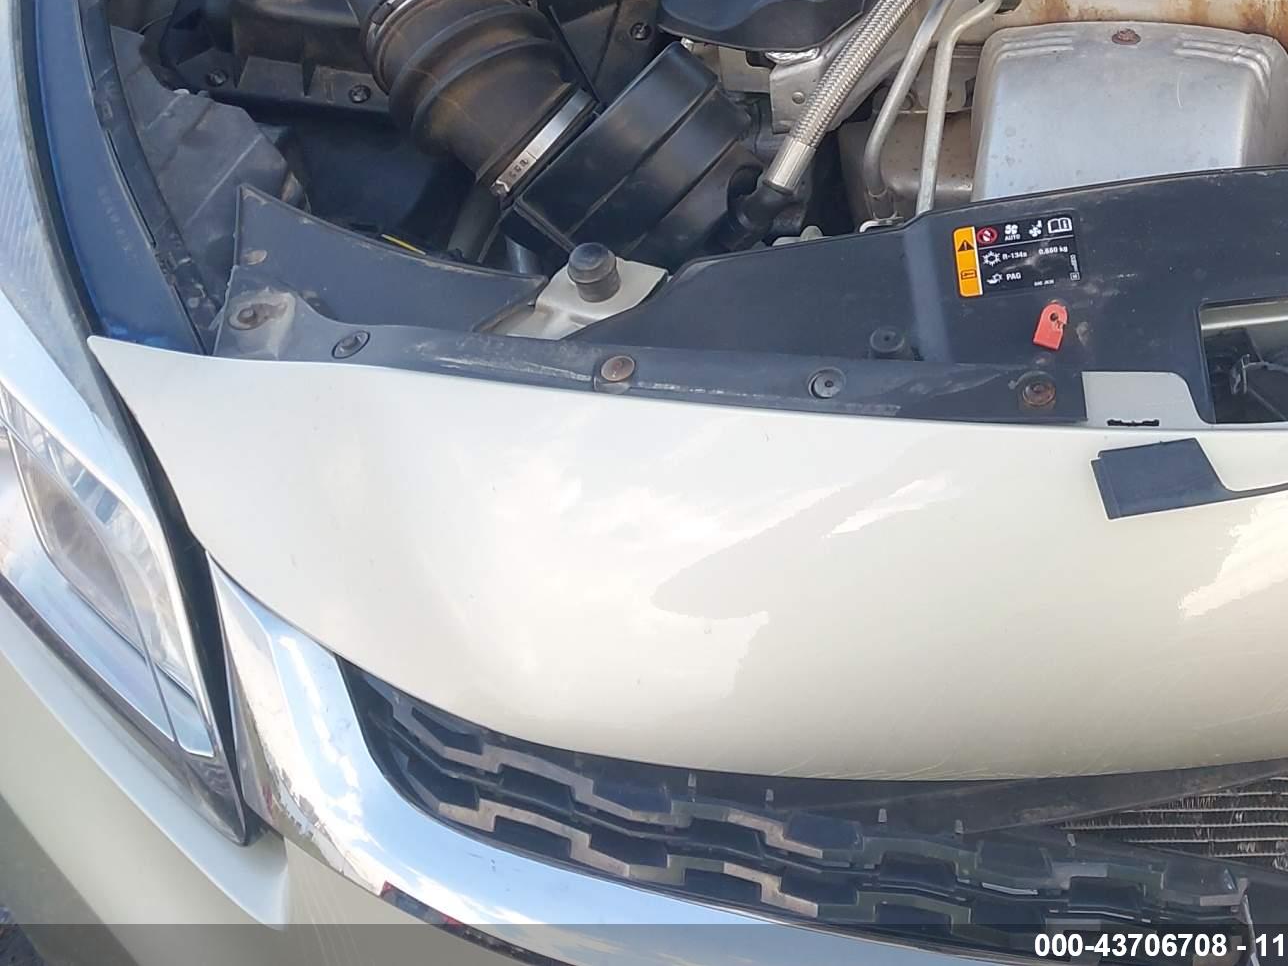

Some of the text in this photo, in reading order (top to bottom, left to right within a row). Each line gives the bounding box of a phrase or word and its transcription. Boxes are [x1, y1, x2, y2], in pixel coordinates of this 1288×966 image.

[1004, 233, 1021, 242] AUTO
[1002, 251, 1028, 261] R-134a
[1006, 272, 1022, 281] PAG
